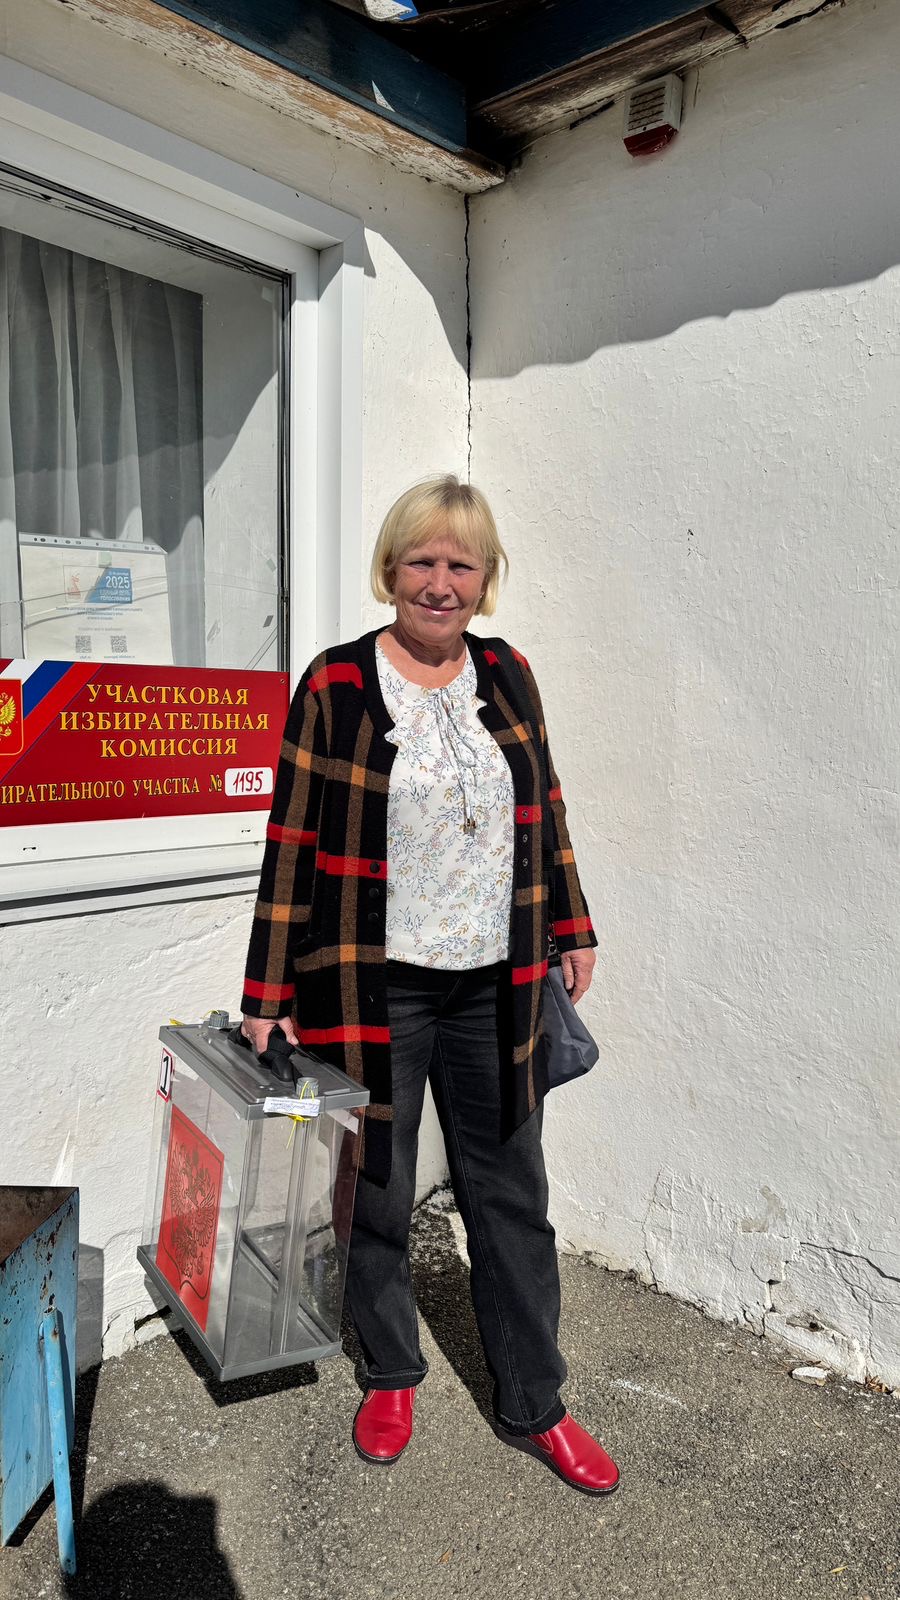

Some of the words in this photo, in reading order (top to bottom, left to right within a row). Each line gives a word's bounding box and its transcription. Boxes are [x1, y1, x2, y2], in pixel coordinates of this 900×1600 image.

[105, 575, 130, 589] 2025
[86, 683, 249, 705] УЧАСТКОВАЯ
[59, 711, 269, 731] ИЗБИРАТЕЛЬНАЯ
[100, 737, 238, 758] КОМИССИЯ
[1, 779, 126, 804] ИРАТЕЛЬНОГО
[133, 777, 201, 797] УЧАСТКА
[208, 774, 223, 792] №
[232, 771, 264, 794] 1195
[160, 1055, 169, 1096] 1
